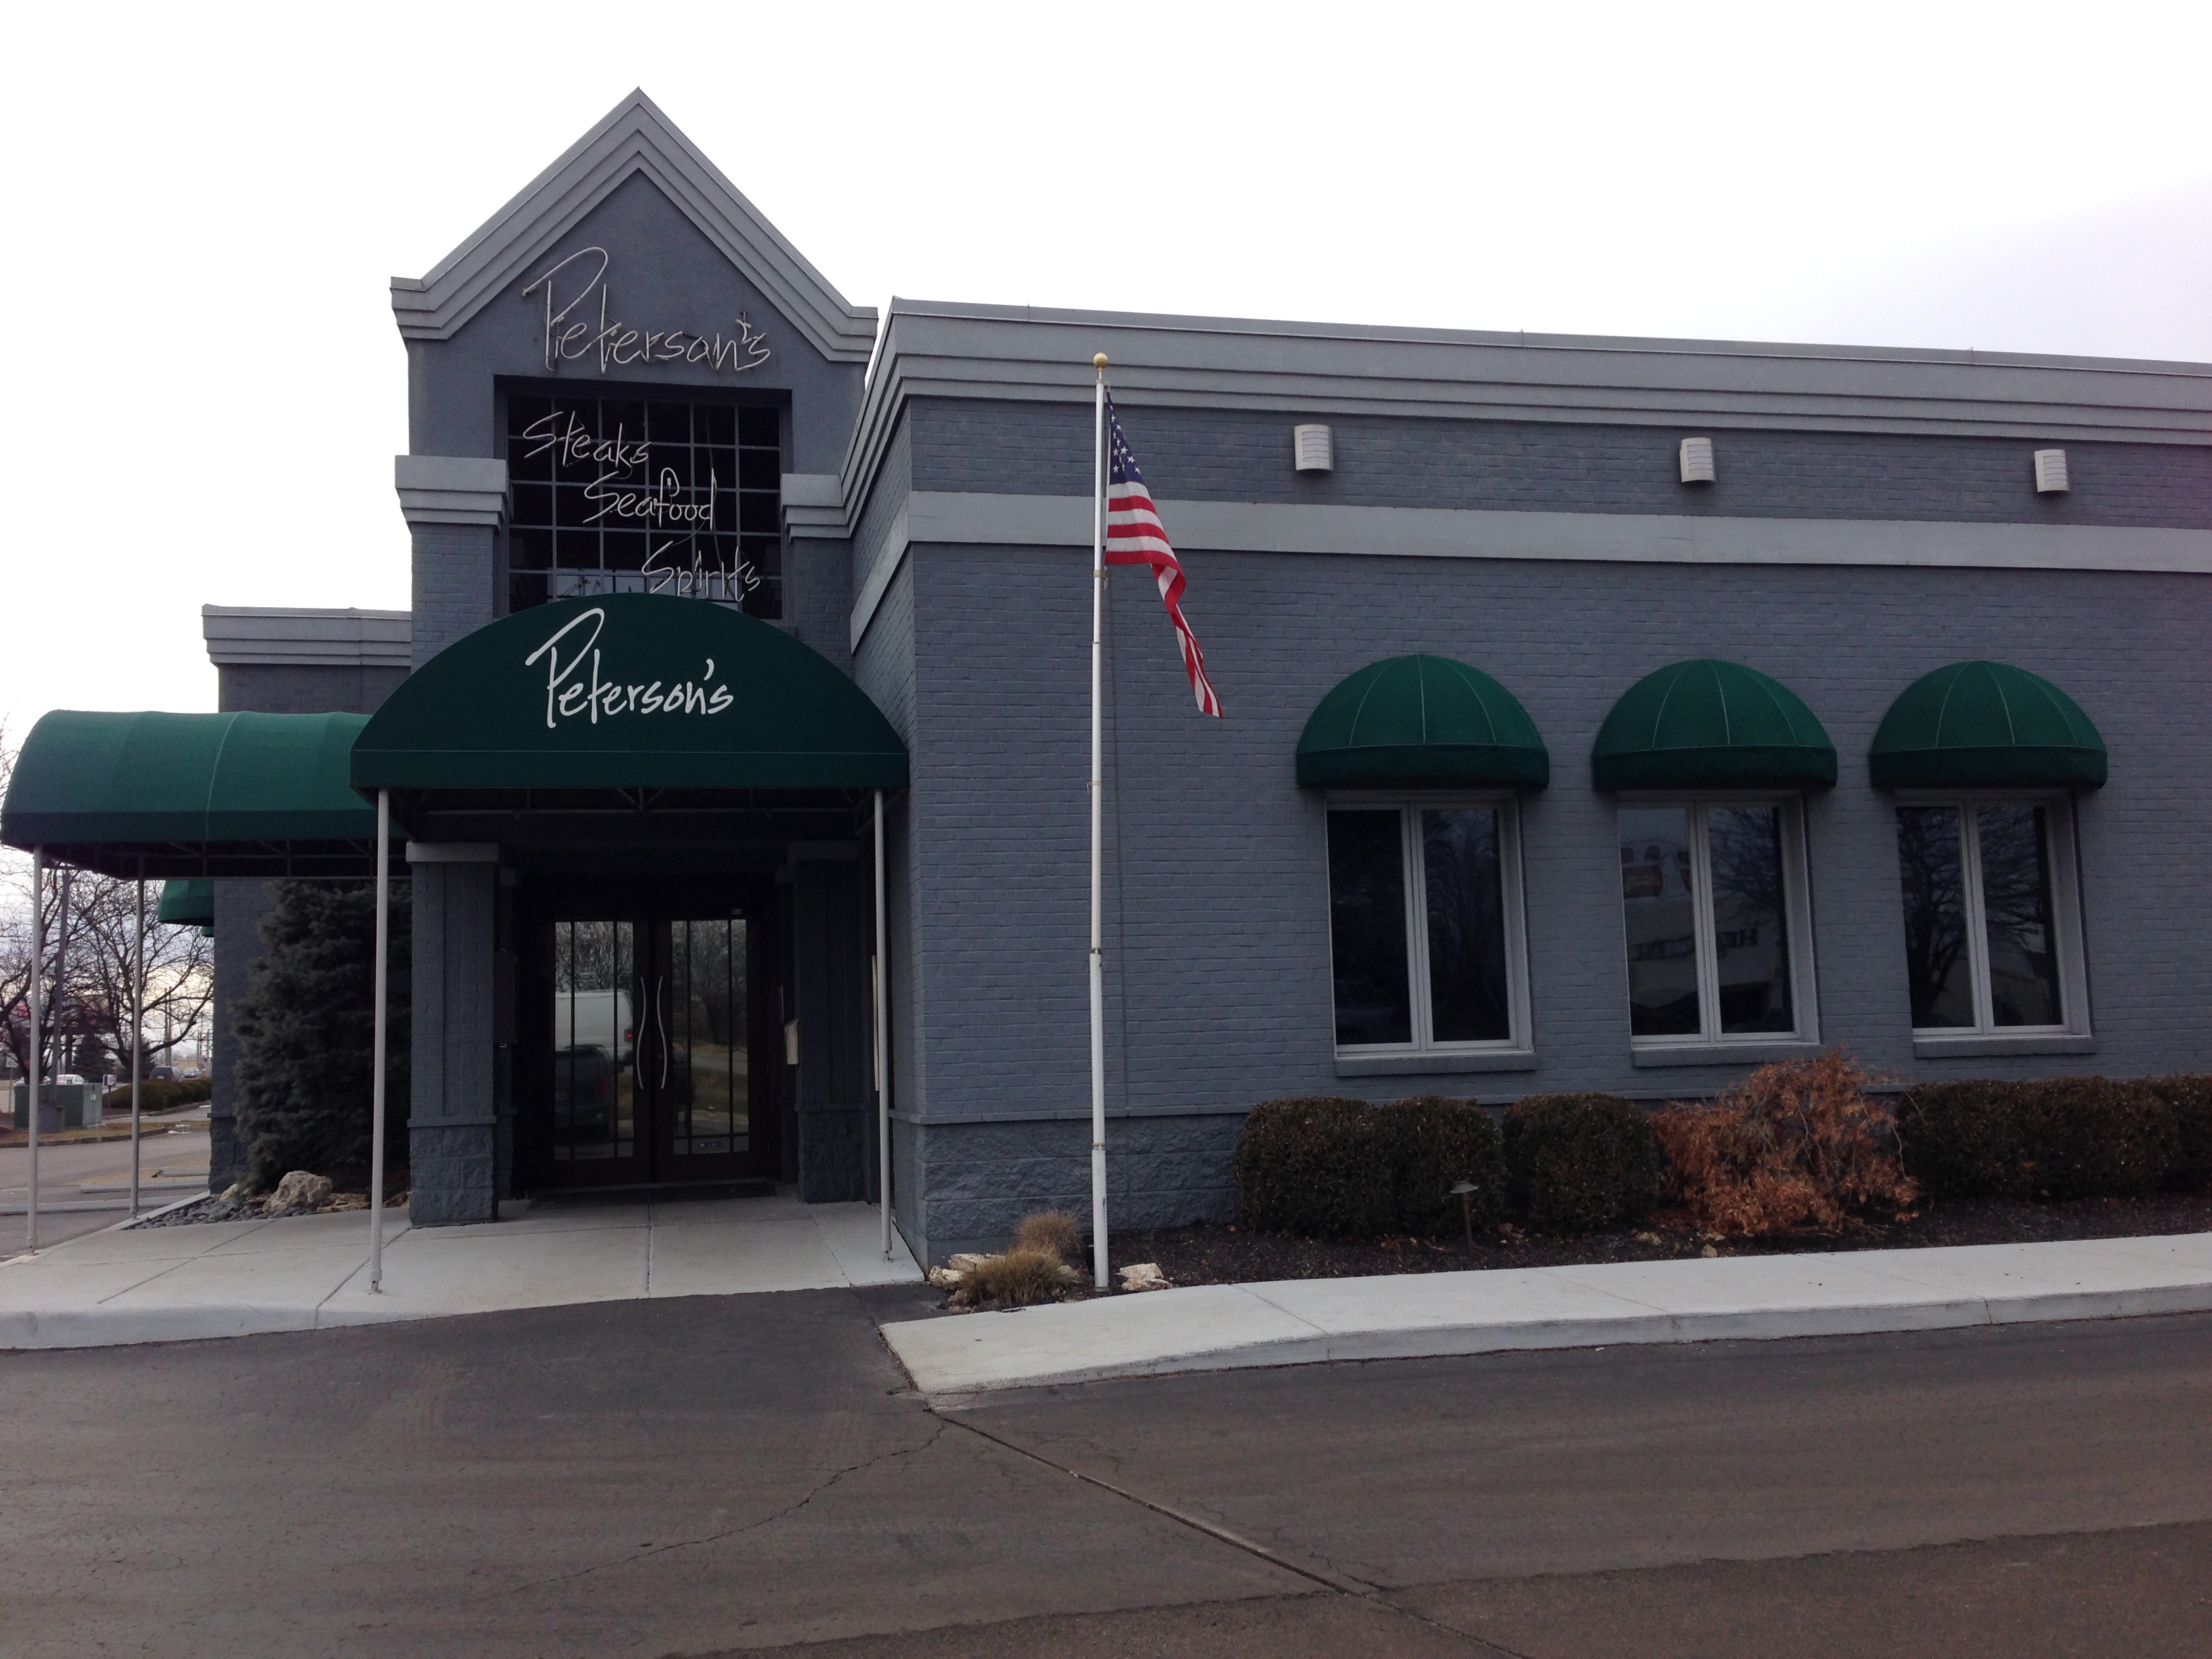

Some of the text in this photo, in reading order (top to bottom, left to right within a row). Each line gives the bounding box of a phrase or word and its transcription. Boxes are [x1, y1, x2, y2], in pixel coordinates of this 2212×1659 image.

[522, 247, 771, 374] Peterson's
[523, 410, 653, 467] Steaks
[583, 467, 716, 531] Seafood
[641, 540, 760, 602] Spirits
[525, 607, 734, 729] Peterson's
